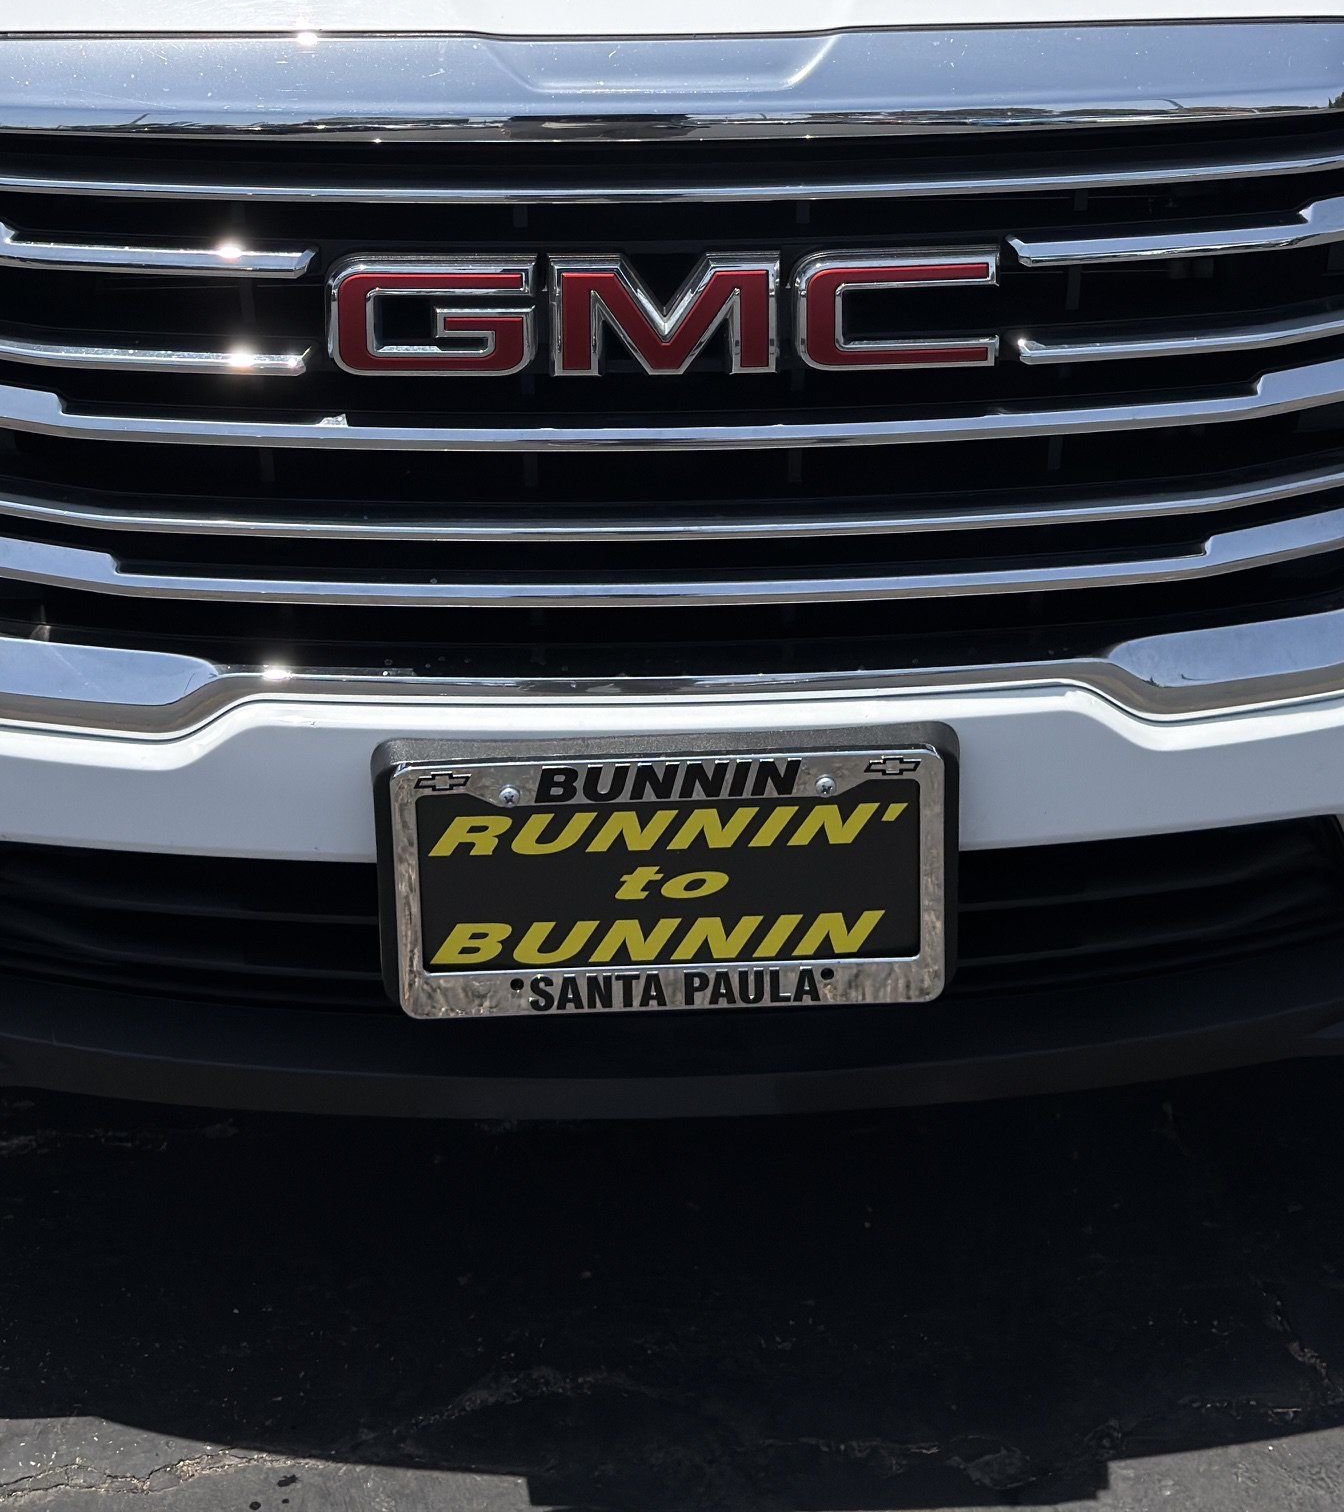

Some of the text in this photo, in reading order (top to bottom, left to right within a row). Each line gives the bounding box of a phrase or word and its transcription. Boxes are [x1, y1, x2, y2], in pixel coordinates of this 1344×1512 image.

[325, 245, 1001, 377] GMC
[533, 757, 803, 804] BUNNIN
[427, 802, 909, 858] RUNNIN'
[613, 865, 730, 901] to
[429, 909, 886, 966] BUNNIN
[528, 966, 822, 1012] SANTA PAULA
